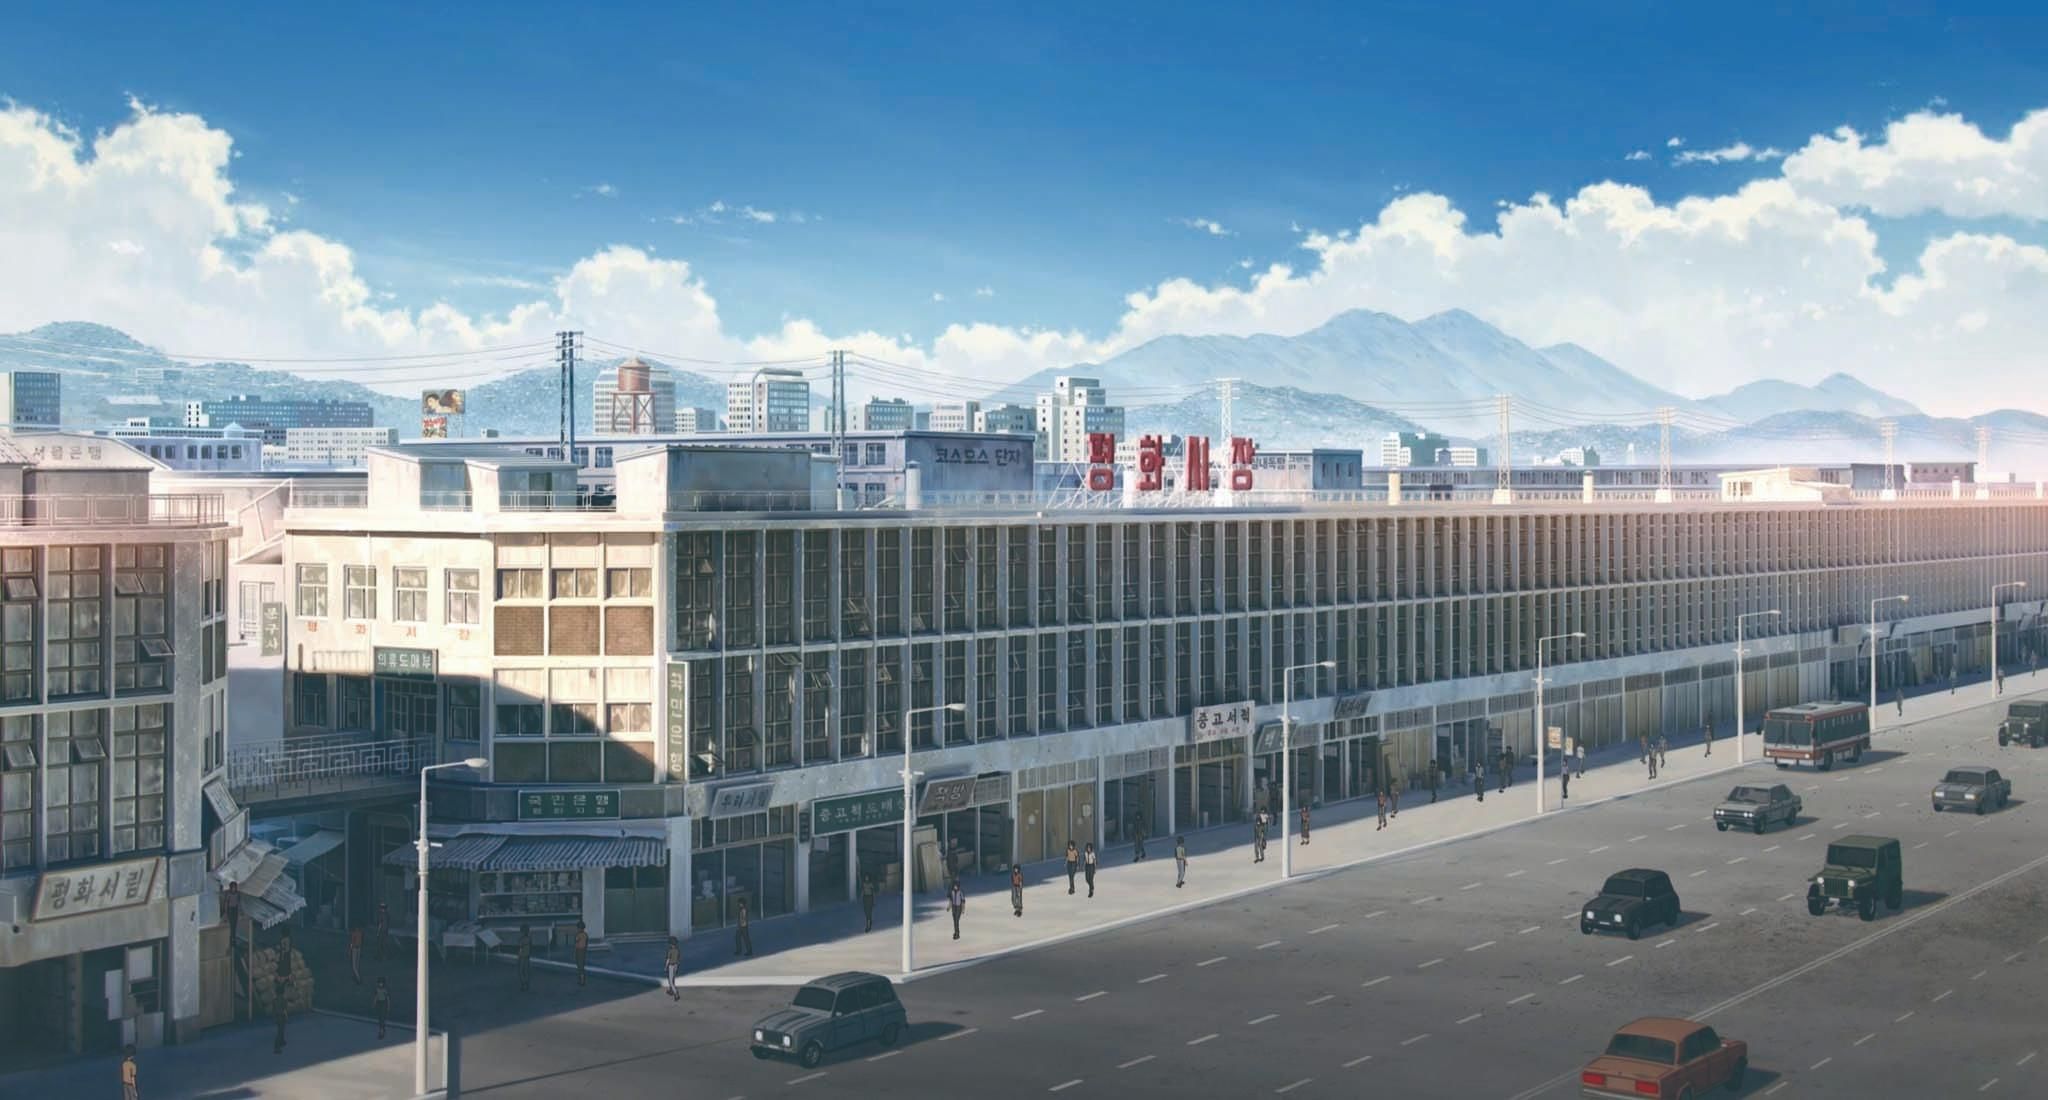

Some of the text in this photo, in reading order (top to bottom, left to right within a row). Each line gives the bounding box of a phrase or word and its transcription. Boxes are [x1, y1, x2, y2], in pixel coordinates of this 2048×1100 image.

[936, 448, 989, 464] 코스모스
[1087, 433, 1256, 491] 평화시장
[670, 672, 683, 772] 국민은행
[50, 867, 144, 910] 평화서림
